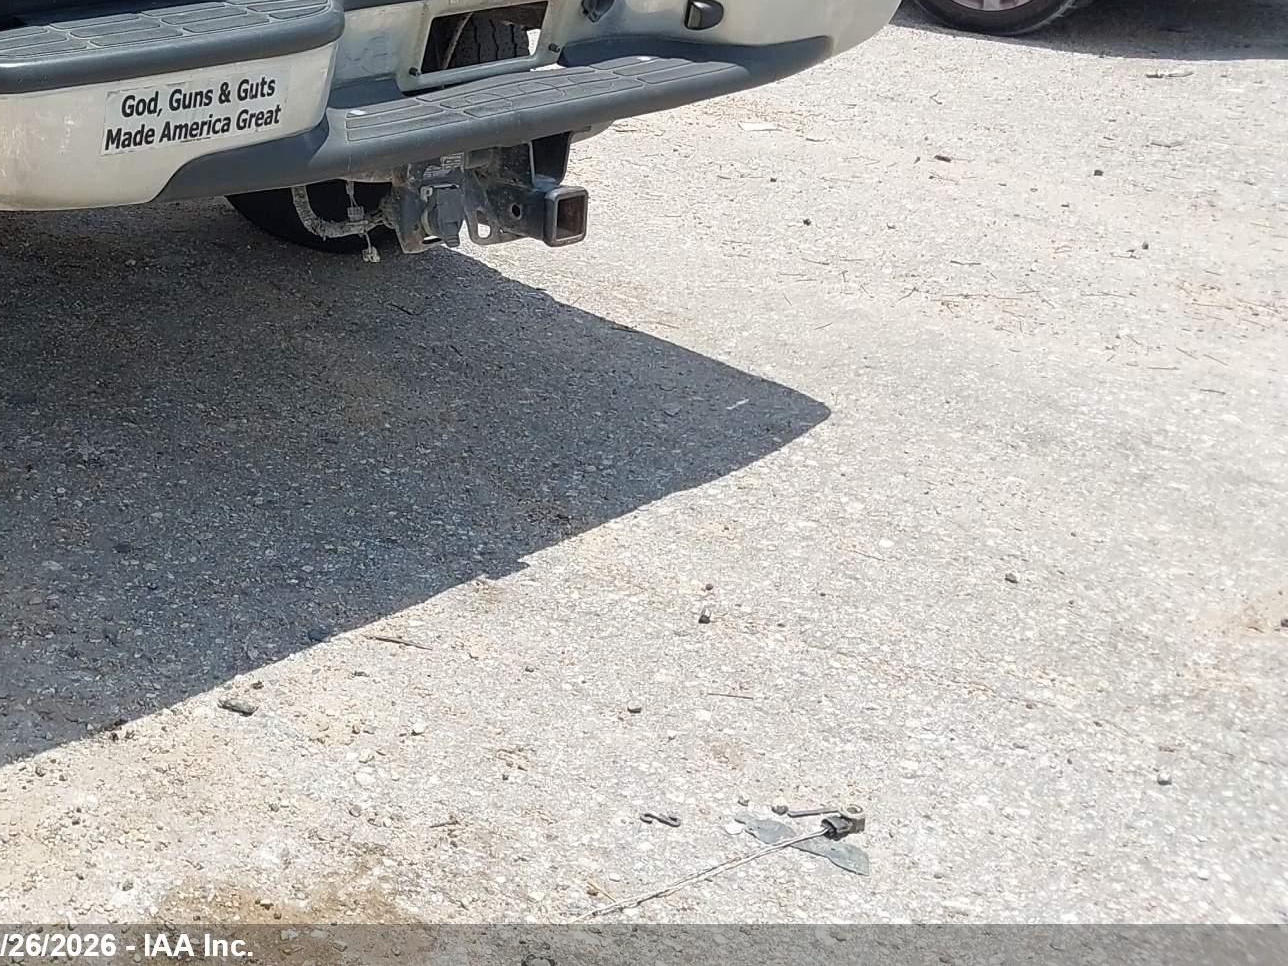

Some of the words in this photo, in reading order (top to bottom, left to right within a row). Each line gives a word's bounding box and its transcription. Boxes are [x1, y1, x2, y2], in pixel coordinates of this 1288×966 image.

[121, 90, 163, 117] God,
[168, 88, 213, 111] Guns
[218, 81, 232, 104] &
[236, 76, 276, 101] Guts
[104, 123, 155, 151] Made
[159, 113, 231, 143] America
[235, 104, 282, 131] Great
